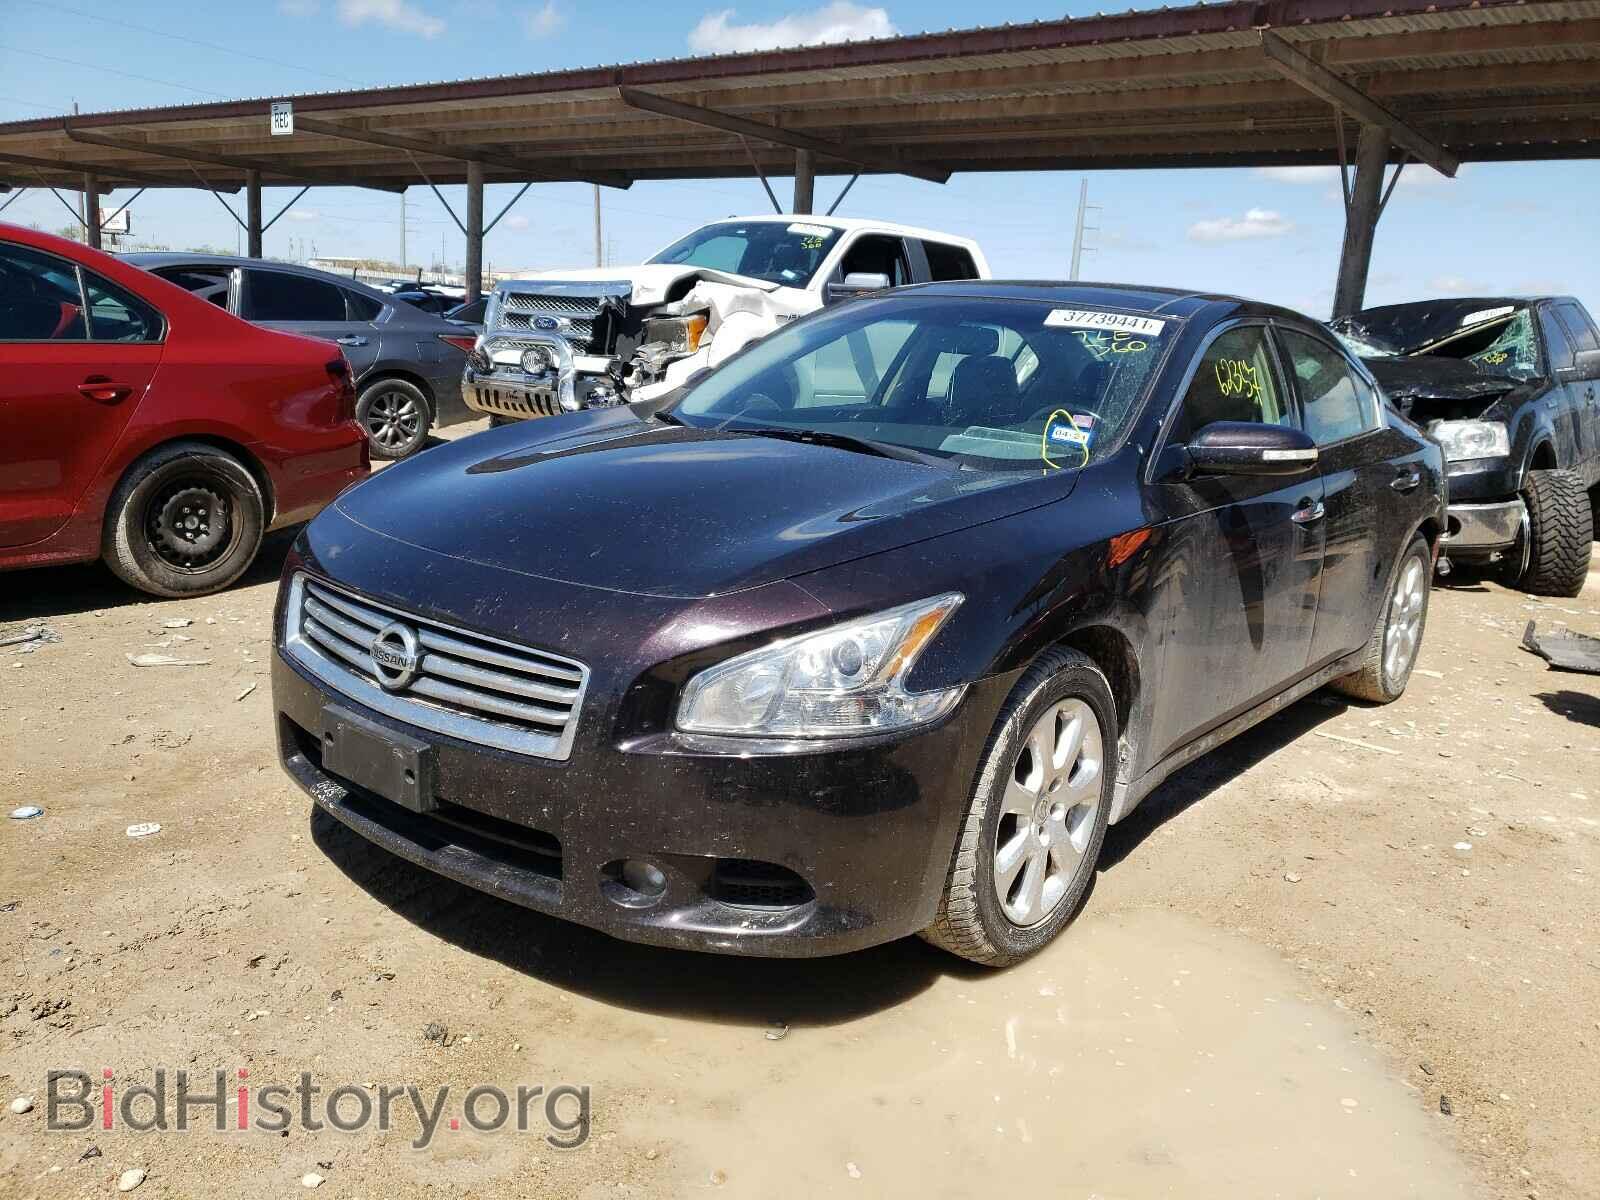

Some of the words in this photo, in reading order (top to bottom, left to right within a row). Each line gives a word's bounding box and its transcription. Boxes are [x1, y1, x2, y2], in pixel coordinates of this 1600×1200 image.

[274, 112, 289, 128] REC
[1063, 311, 1147, 330] 37739441
[371, 643, 408, 668] NISSAN
